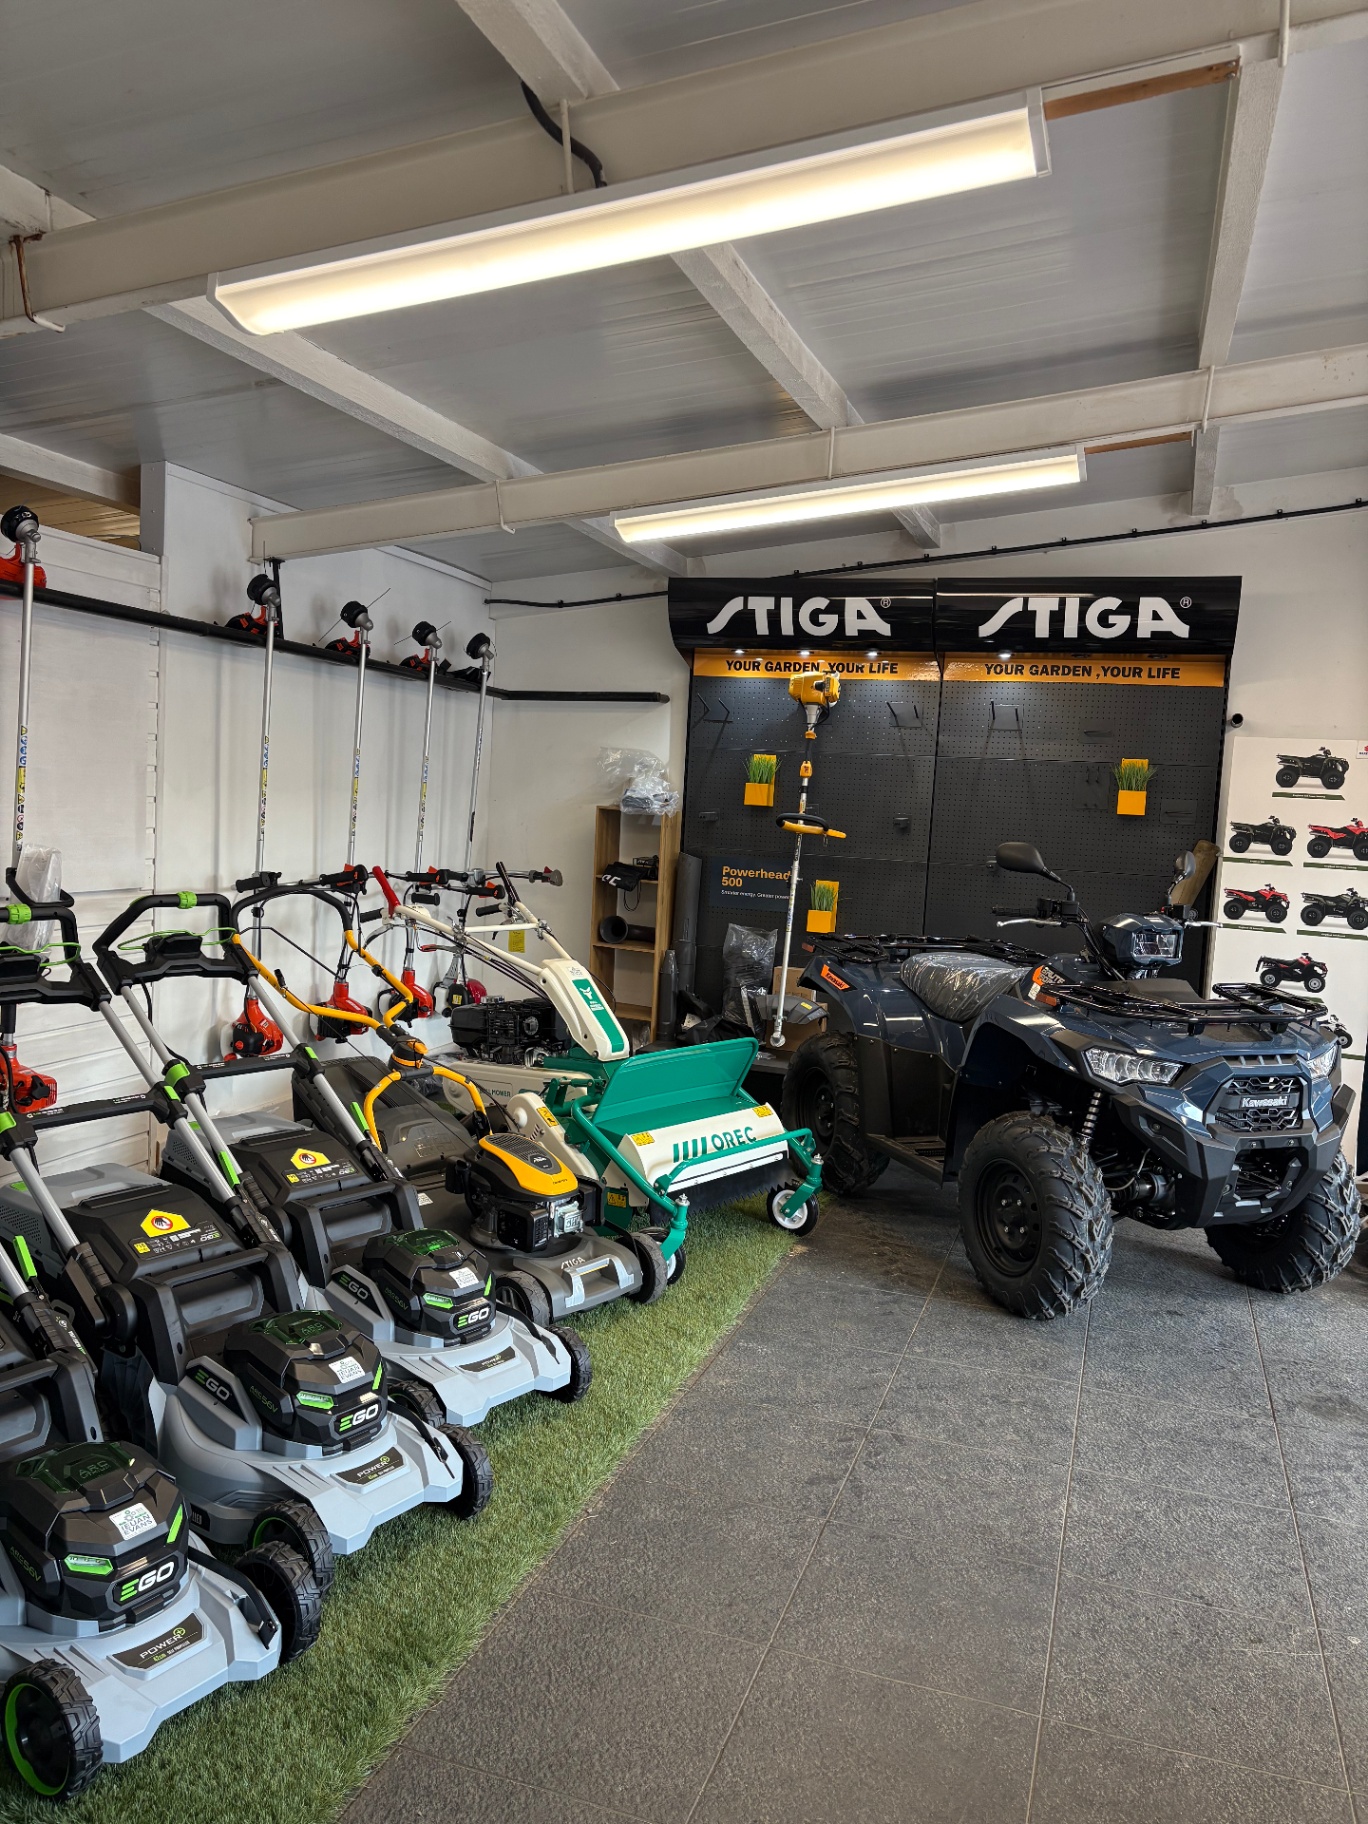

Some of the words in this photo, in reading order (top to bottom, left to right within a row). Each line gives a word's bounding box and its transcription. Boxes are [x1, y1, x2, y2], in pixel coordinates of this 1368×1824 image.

[726, 660, 761, 672] YOUR
[764, 661, 820, 674] GARDEN
[869, 662, 898, 674] LIFE
[984, 663, 1024, 676] YOUR
[1029, 664, 1092, 677] GARDEN
[1147, 667, 1181, 679] LIFE
[721, 876, 743, 887] 500
[722, 865, 791, 881] Powerhead
[1241, 1095, 1288, 1108] Kawasaki
[711, 1126, 757, 1151] OREC
[560, 1256, 586, 1270] STIGA
[338, 1274, 369, 1300] EGO
[457, 1307, 490, 1328] EGO
[194, 1369, 231, 1401] EGO
[338, 1403, 379, 1432] EGO
[357, 1460, 389, 1478] POWER
[119, 1561, 175, 1602] EGO
[139, 1633, 184, 1659] POWER
